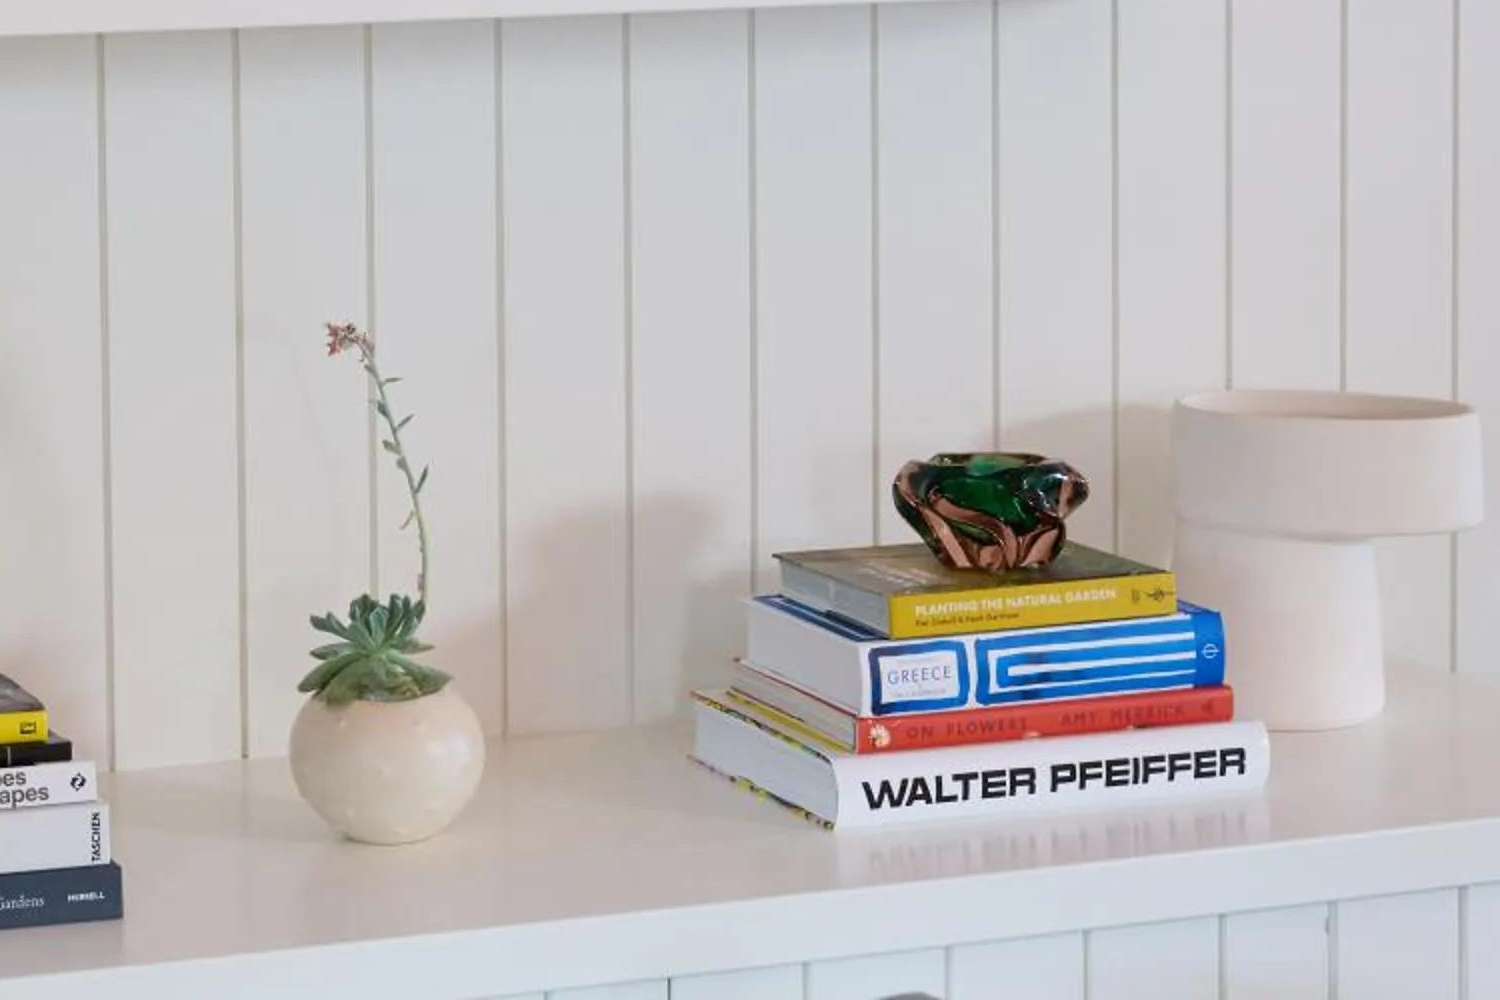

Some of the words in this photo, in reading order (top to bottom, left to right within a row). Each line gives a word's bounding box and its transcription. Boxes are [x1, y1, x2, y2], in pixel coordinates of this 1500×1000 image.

[914, 600, 979, 617] PLANTING
[980, 598, 1006, 612] THE
[1008, 592, 1063, 609] NATURAL
[1064, 588, 1117, 602] GARDEN
[886, 664, 953, 686] GREECE
[905, 725, 935, 740] ON
[945, 716, 1029, 738] FLOWERS
[1059, 712, 1097, 727] AMY
[1109, 704, 1186, 723] MERRICK
[861, 766, 1037, 811] WALTER
[1049, 746, 1247, 794] PFEIFFER
[91, 811, 102, 863] TASCHEN
